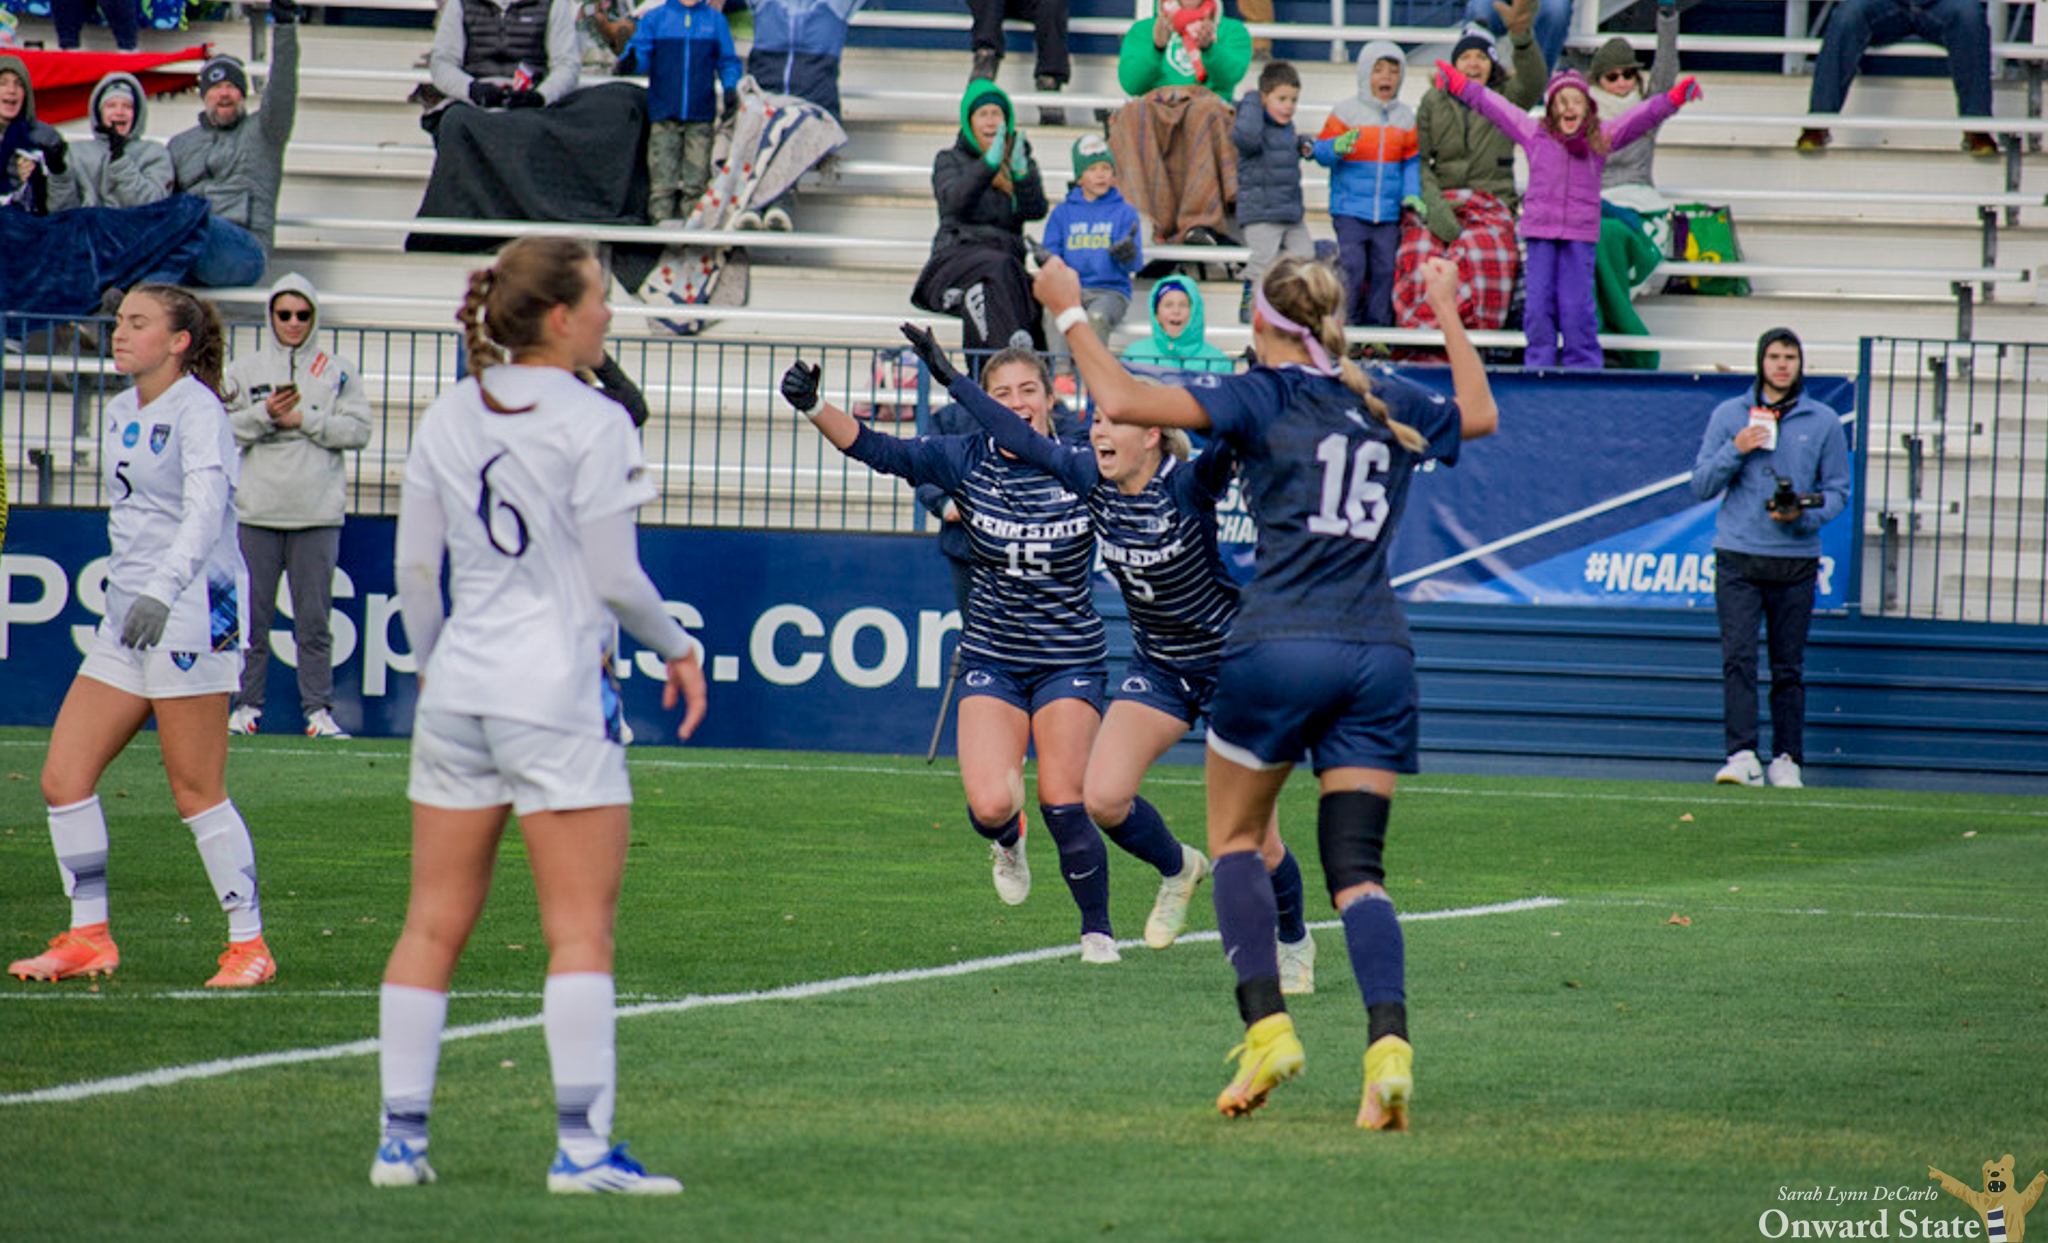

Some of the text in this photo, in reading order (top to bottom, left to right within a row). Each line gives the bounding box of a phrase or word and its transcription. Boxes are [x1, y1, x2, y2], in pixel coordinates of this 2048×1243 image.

[1067, 233, 1111, 249] LEEDS
[115, 461, 132, 500] 5
[1306, 432, 1390, 541] 16
[477, 447, 531, 558] 6
[970, 511, 1091, 540] PENN STATE
[1004, 542, 1052, 577] 15
[1120, 565, 1155, 602] 5
